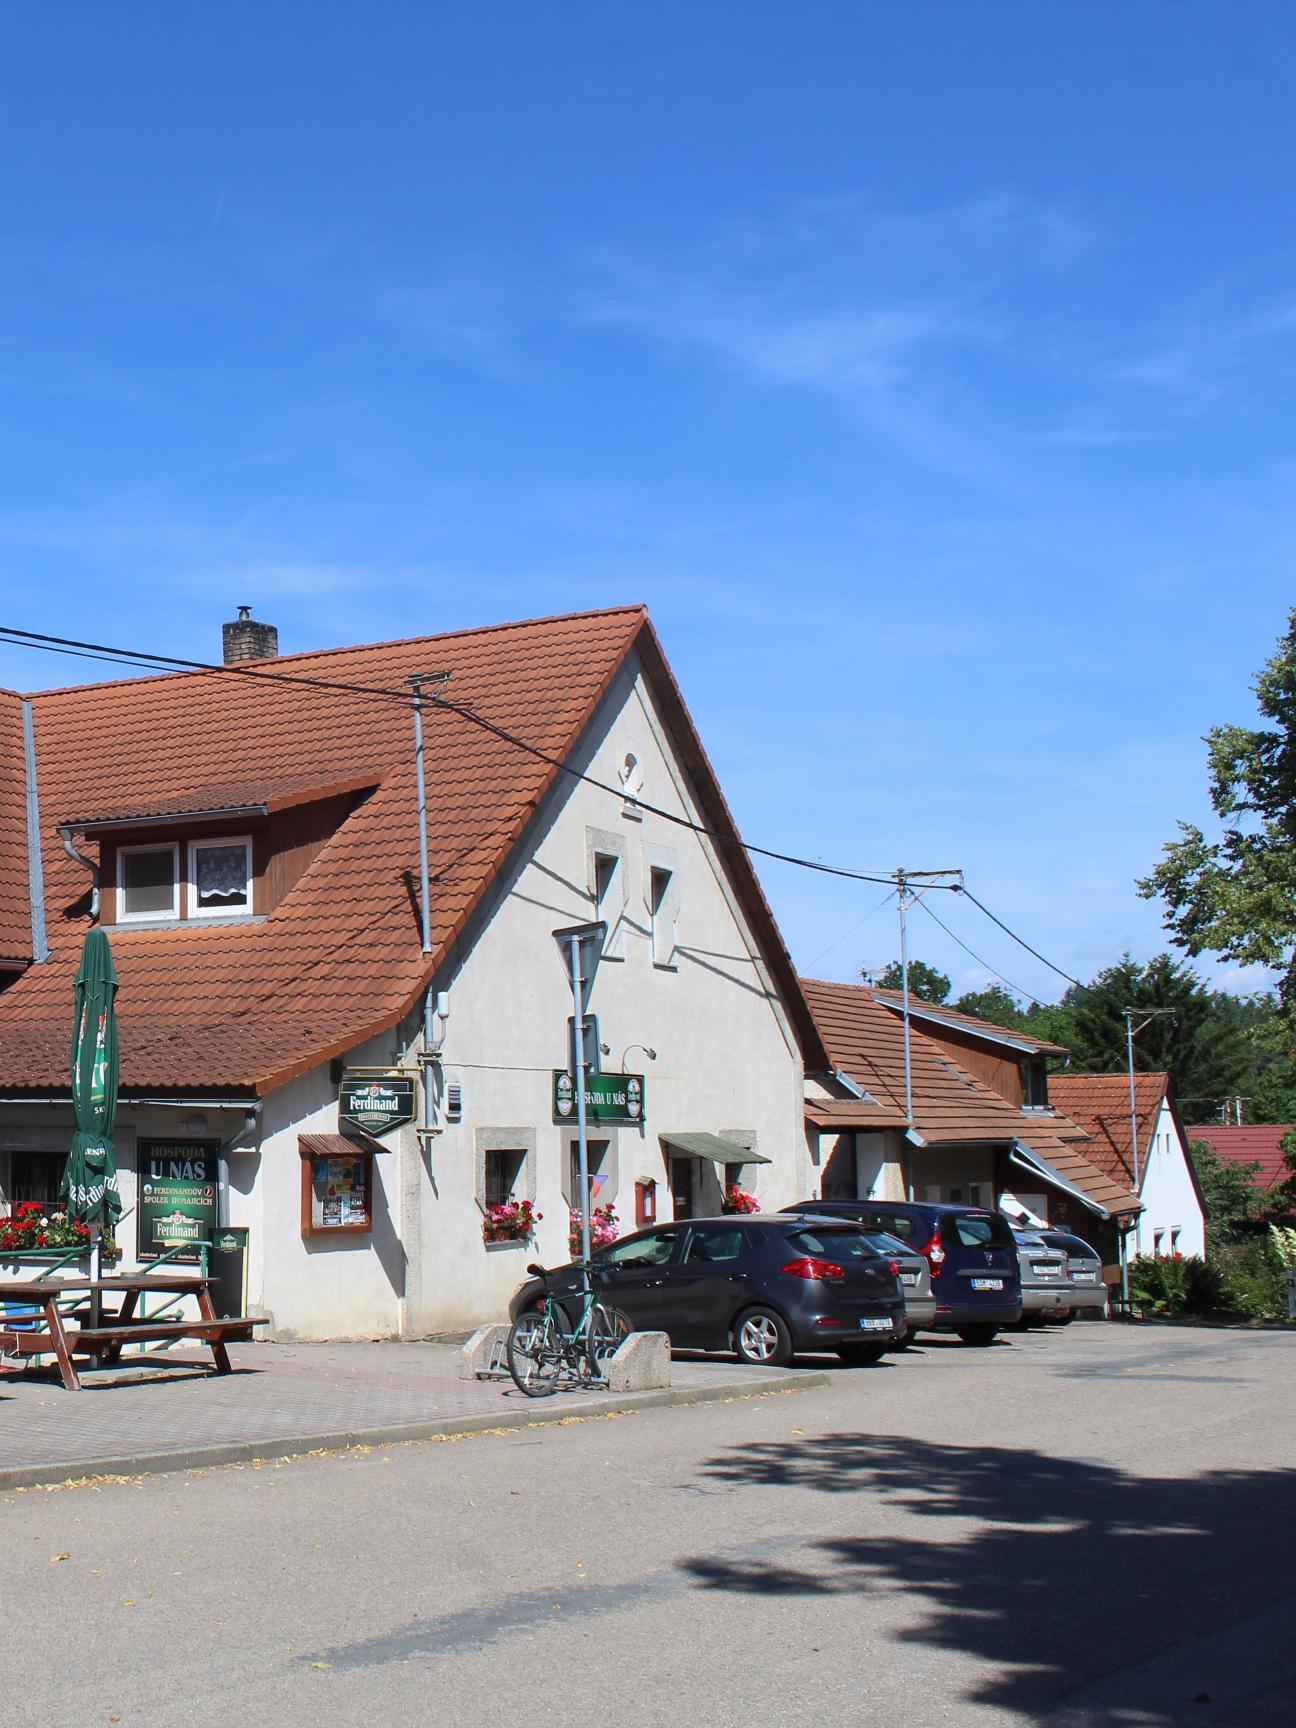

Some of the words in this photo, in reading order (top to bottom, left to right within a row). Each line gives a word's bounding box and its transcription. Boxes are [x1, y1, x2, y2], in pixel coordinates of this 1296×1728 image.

[349, 1095, 399, 1111] Ferdinand
[606, 1092, 612, 1105] U
[150, 1146, 206, 1158] HOSPODA
[150, 1160, 163, 1180] U
[169, 1157, 206, 1180] NÁS
[143, 1196, 169, 1204] SPOLEK
[156, 1222, 199, 1238] Ferdinand
